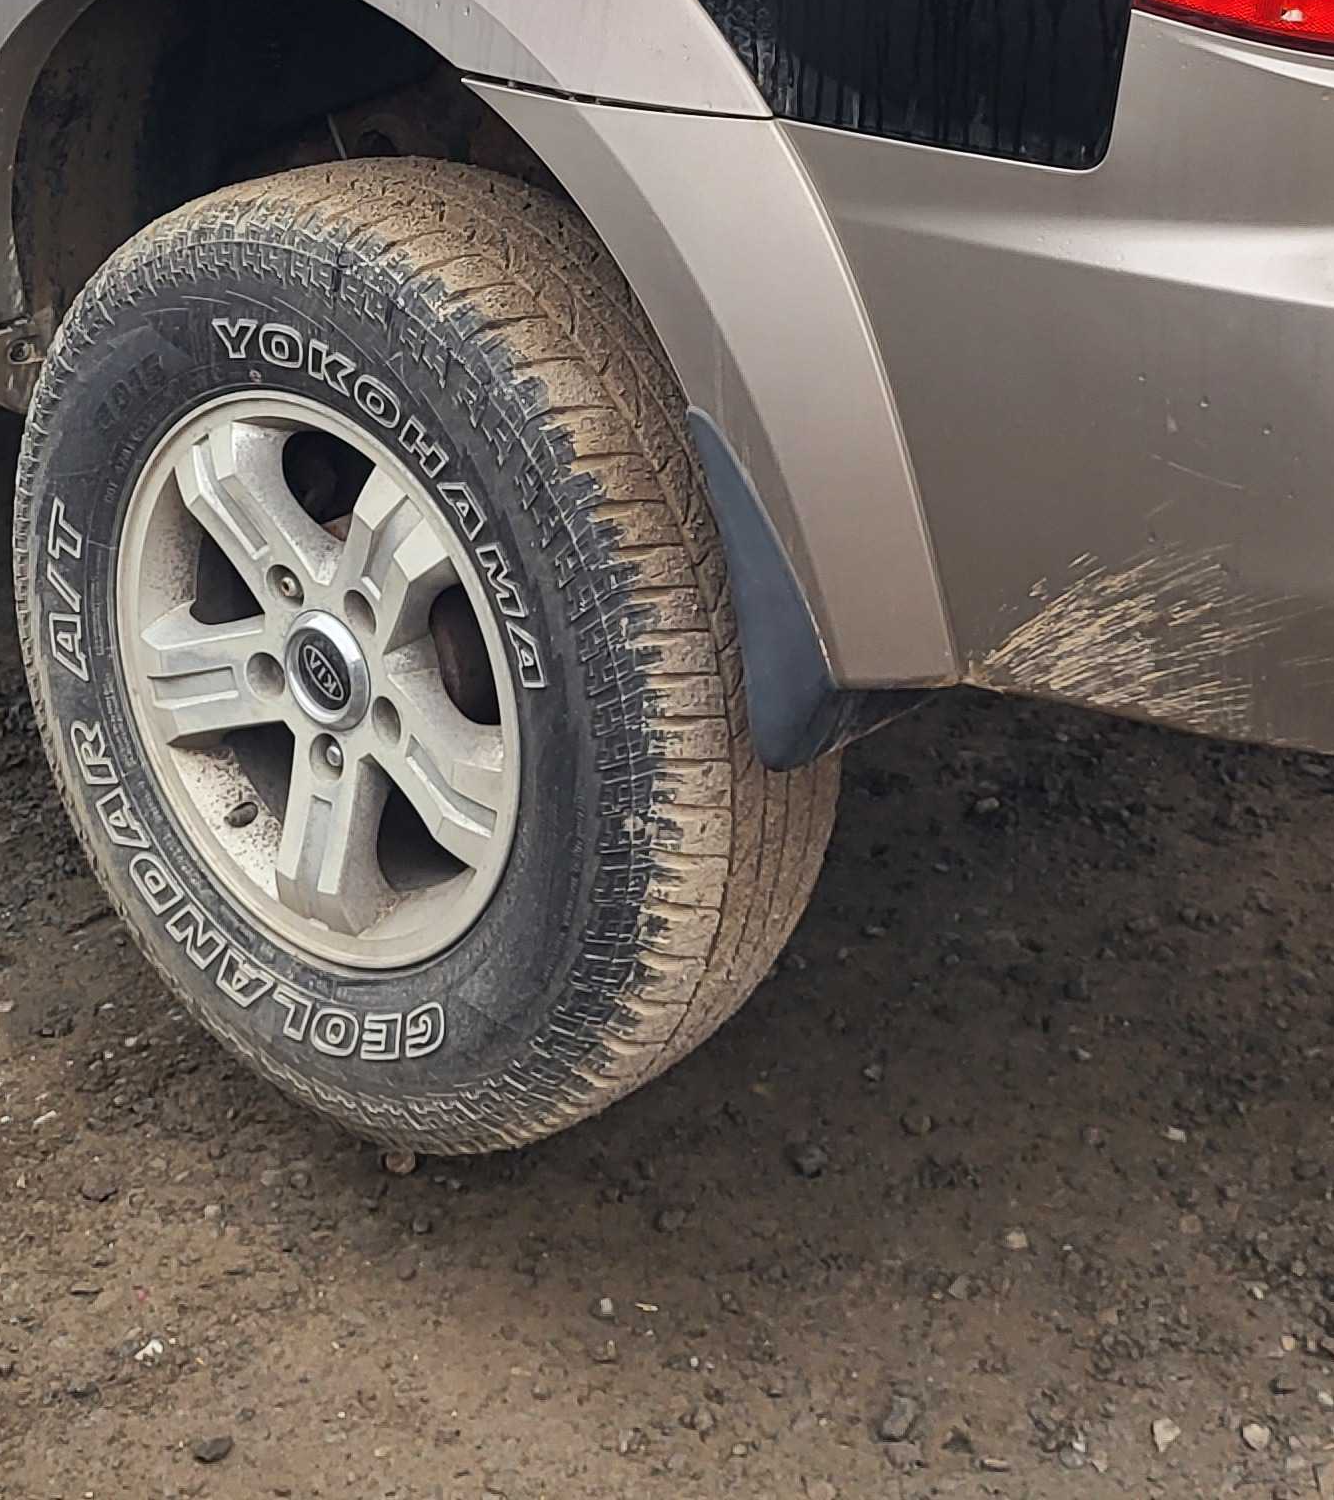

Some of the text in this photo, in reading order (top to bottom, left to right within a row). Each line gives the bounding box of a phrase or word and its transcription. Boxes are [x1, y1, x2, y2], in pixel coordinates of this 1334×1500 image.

[211, 318, 547, 690] YOKOHAMA
[307, 647, 340, 697] KIA
[46, 496, 445, 1061] GEOLANDAR A/T
